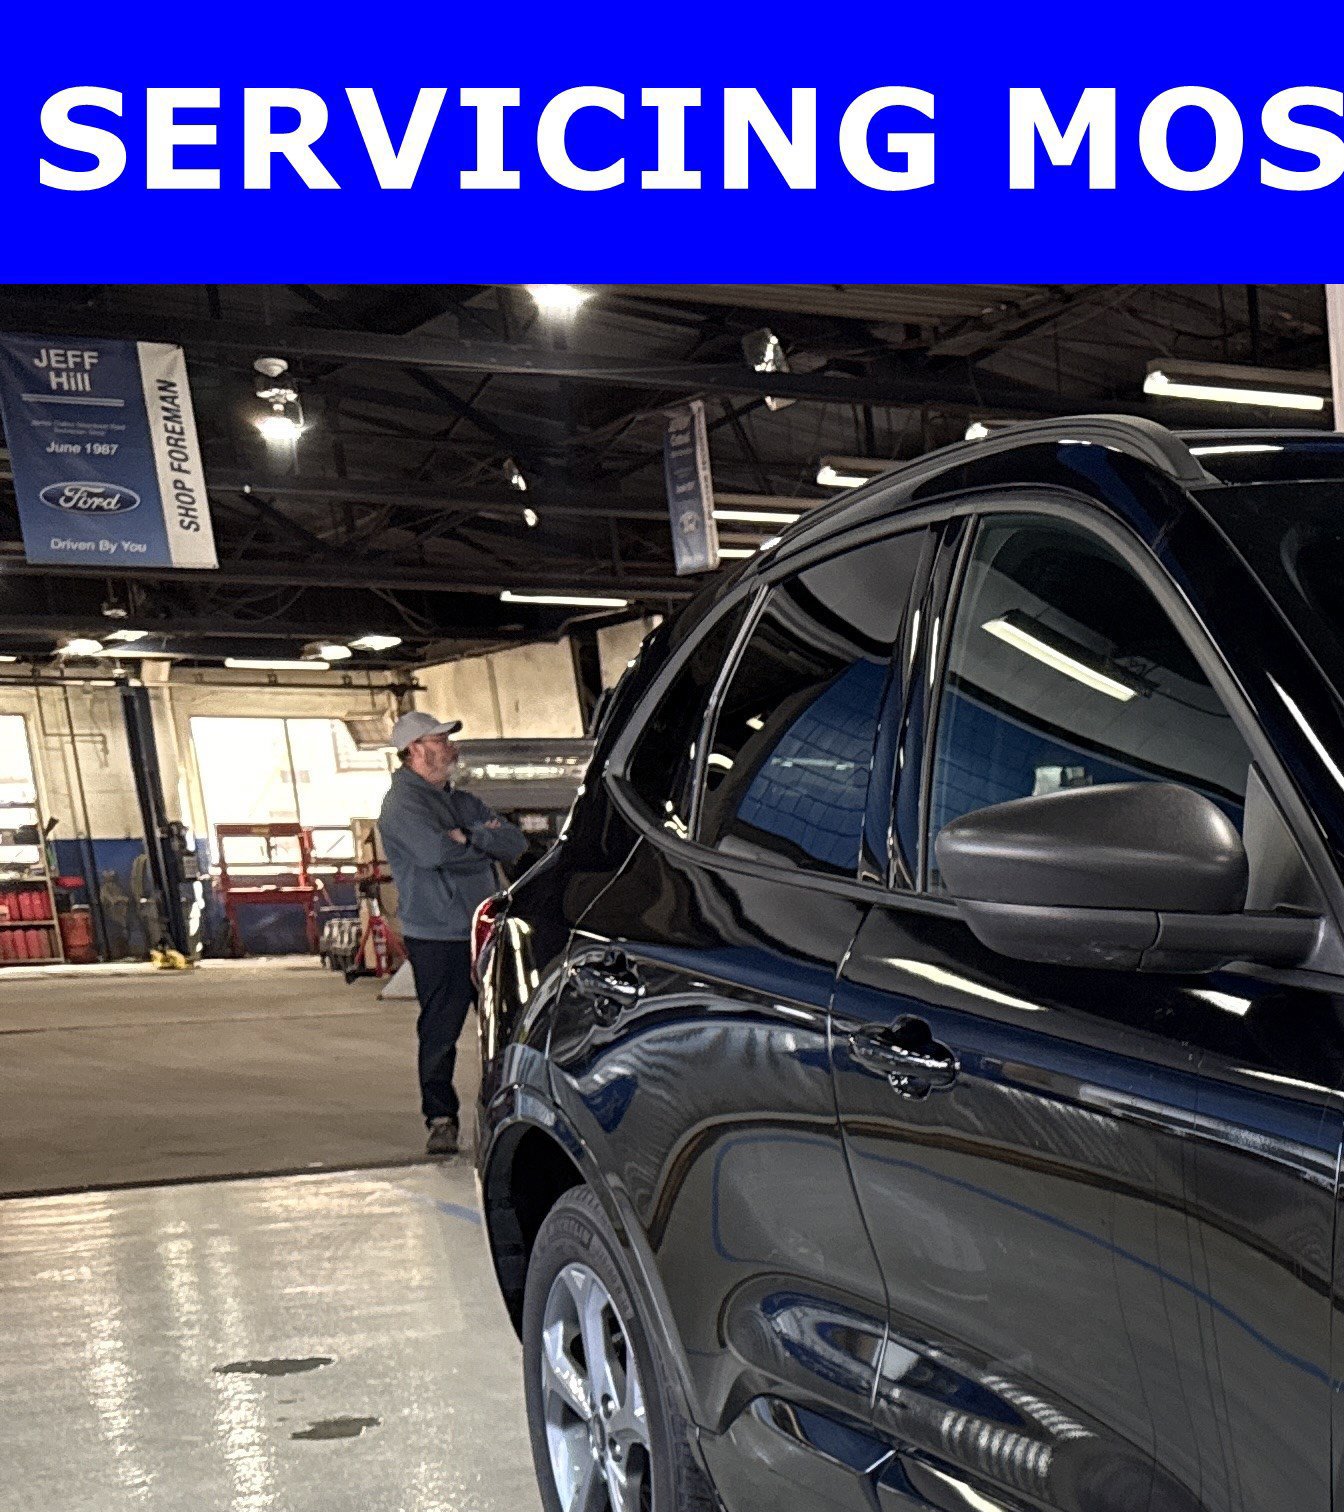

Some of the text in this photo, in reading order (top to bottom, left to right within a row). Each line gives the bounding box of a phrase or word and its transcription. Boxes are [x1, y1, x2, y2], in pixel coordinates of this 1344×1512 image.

[33, 349, 99, 370] JEFF
[50, 371, 91, 392] Hill
[46, 441, 119, 456] June 1987
[156, 379, 200, 532] SHOP FOREMAN
[59, 485, 121, 510] Ford
[50, 537, 147, 554] Driven By You
